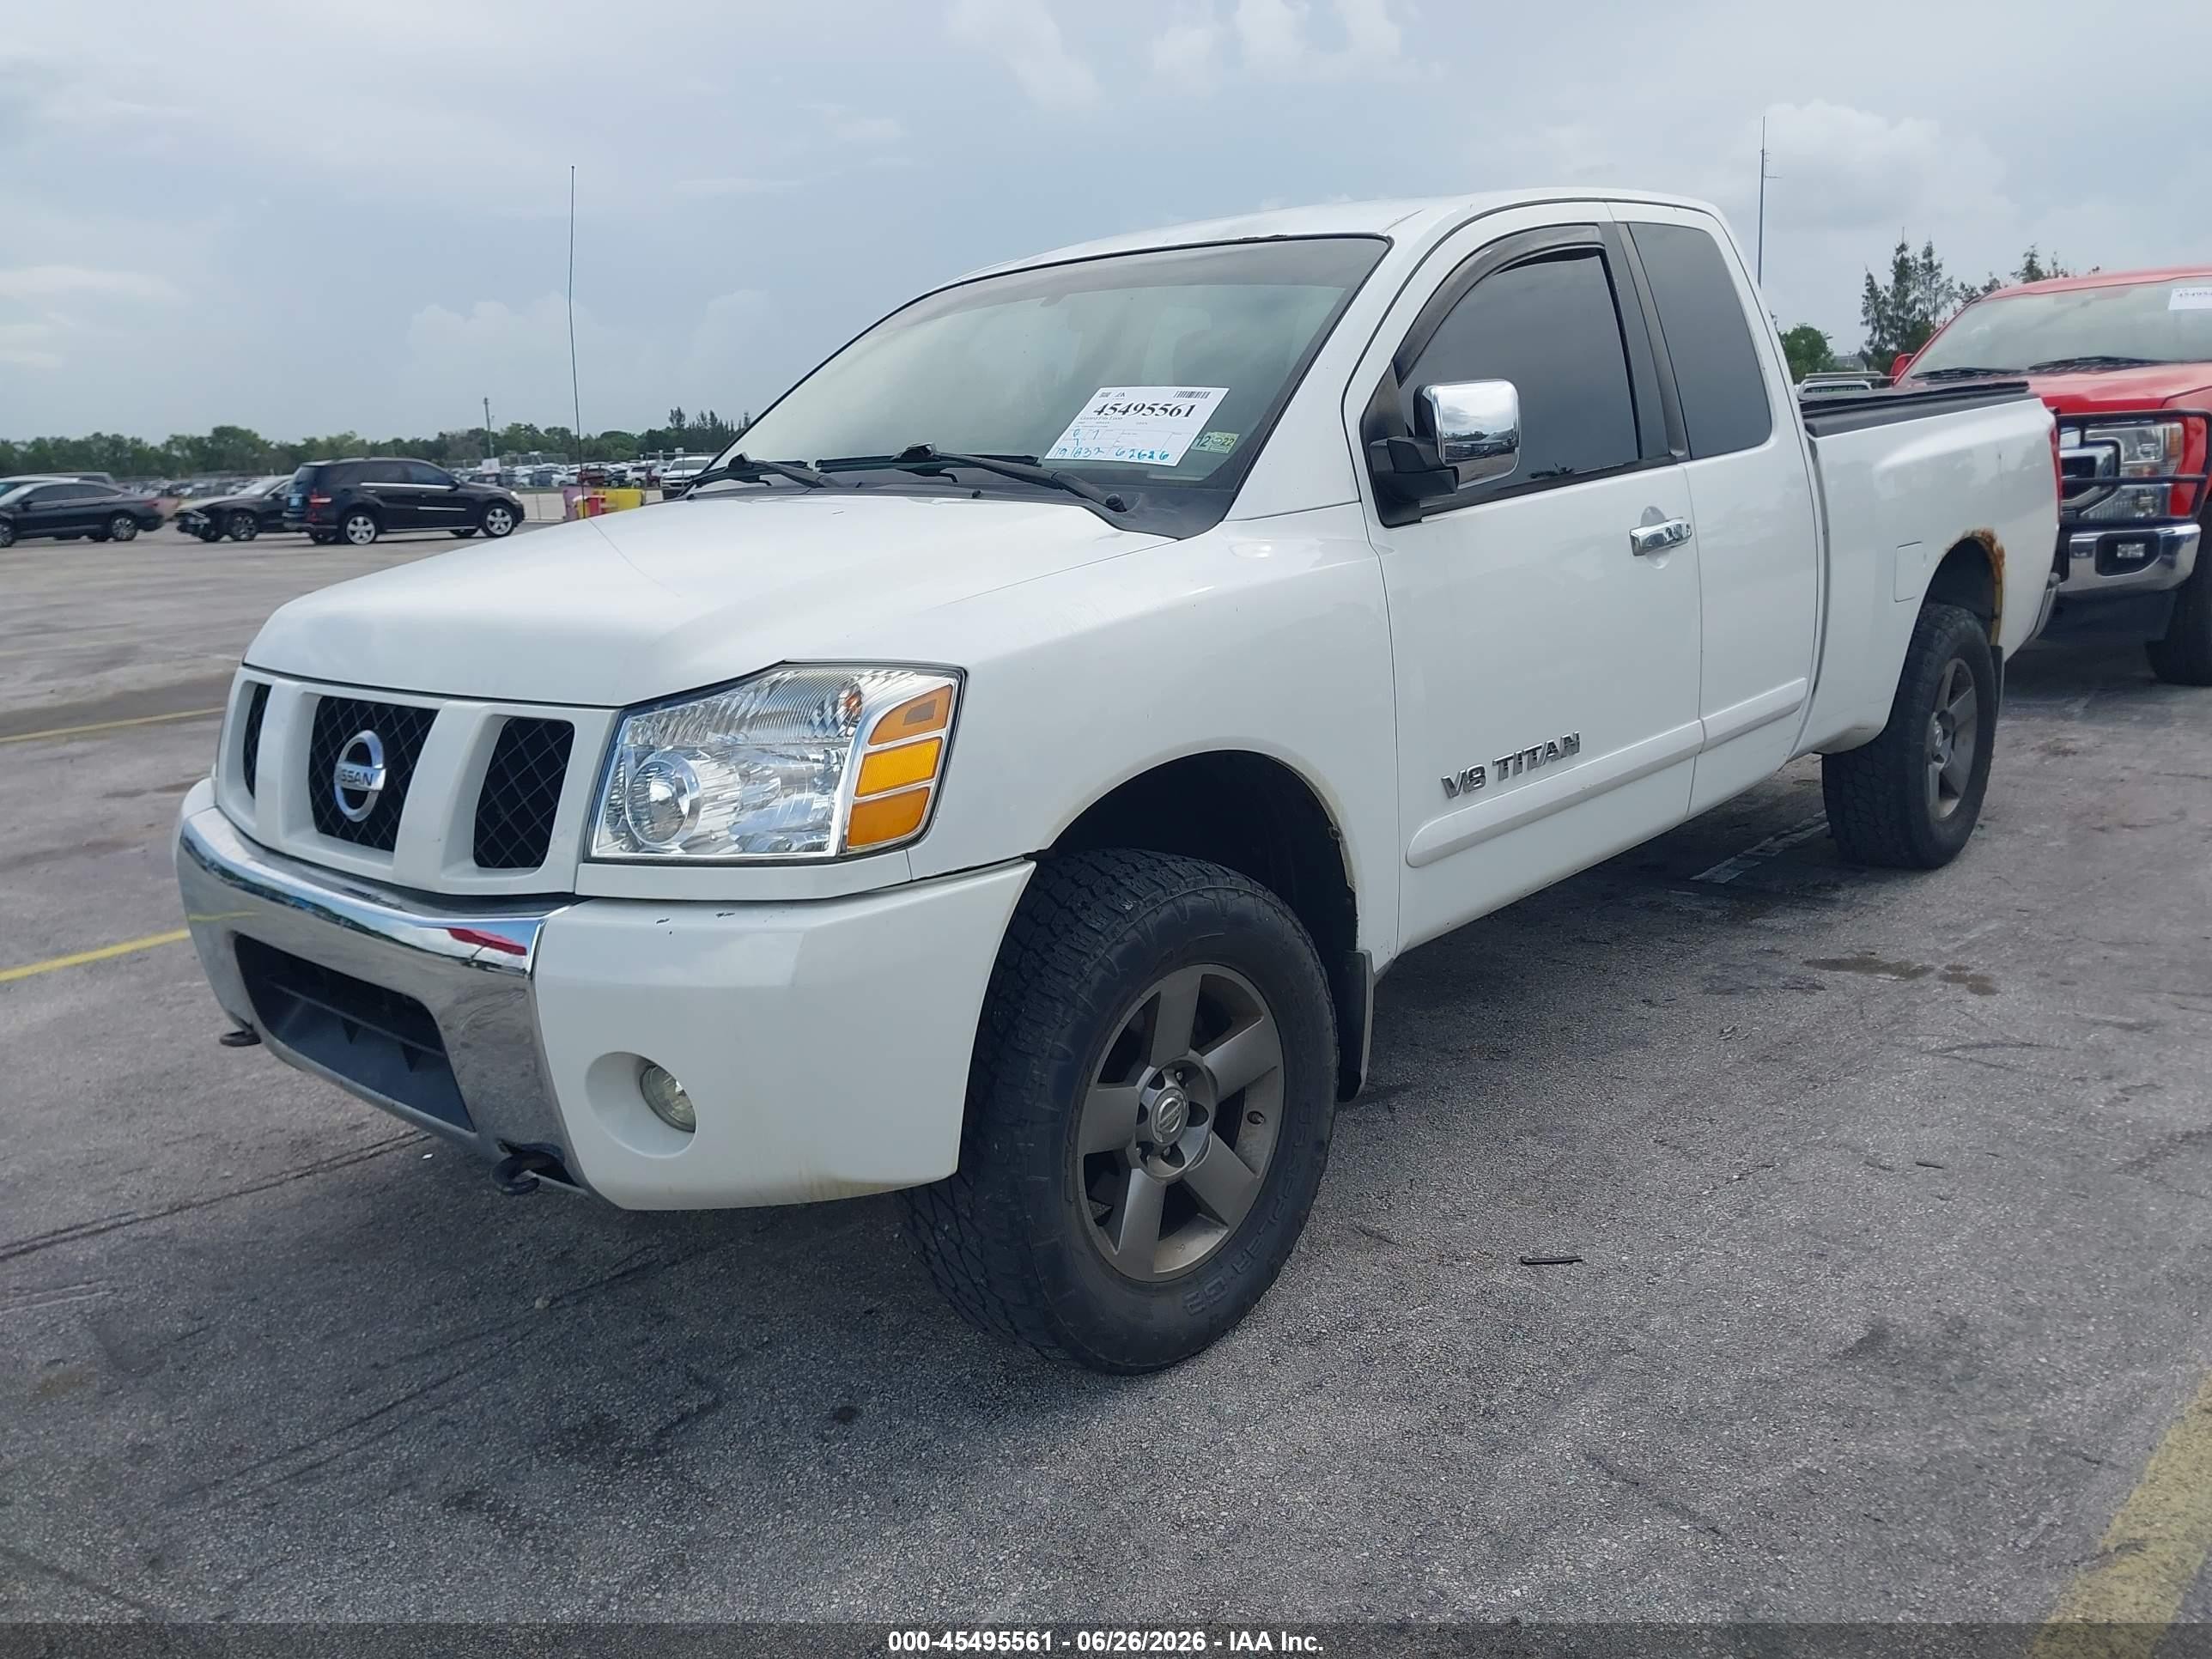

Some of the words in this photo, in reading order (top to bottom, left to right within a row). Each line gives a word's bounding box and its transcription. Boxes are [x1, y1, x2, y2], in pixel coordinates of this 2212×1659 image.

[1093, 402, 1196, 418] 45495561
[1441, 764, 1486, 799] V8
[1492, 731, 1581, 781] TITAN
[336, 768, 374, 787] SSAN
